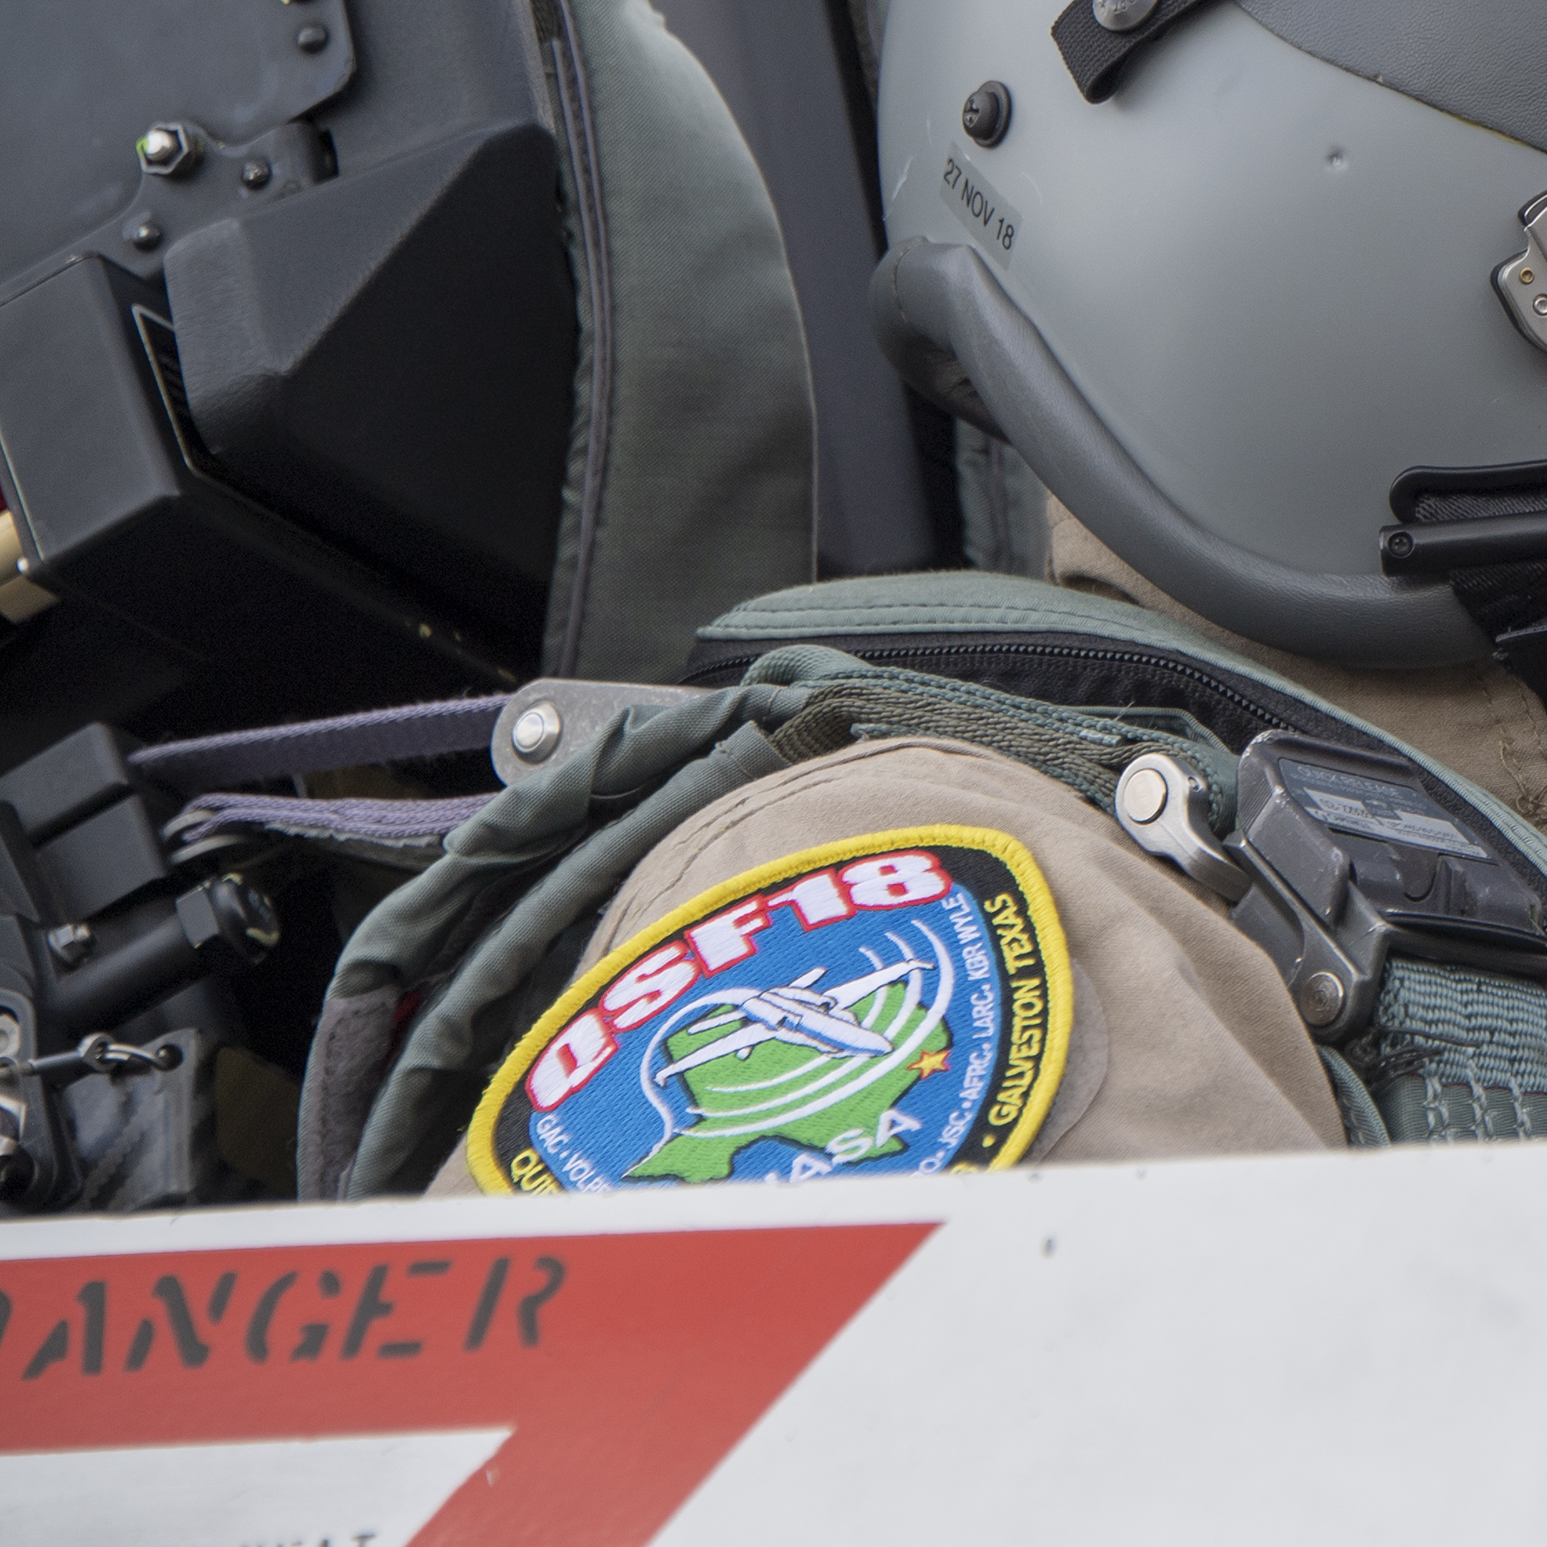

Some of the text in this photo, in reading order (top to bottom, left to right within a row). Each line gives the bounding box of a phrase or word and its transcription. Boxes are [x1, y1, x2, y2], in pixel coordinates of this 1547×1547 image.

[943, 158, 1015, 250] 27 NOV 18
[941, 892, 982, 945] WYLE
[525, 849, 954, 1112] QSF18
[962, 941, 991, 981] KBR
[970, 992, 996, 1039] LARC
[983, 892, 1044, 1126] GALVESTON TEXAS
[959, 1051, 993, 1100] AFRC
[536, 1113, 573, 1154] GAC
[763, 1108, 923, 1185] ASA
[938, 1109, 974, 1150] JSC
